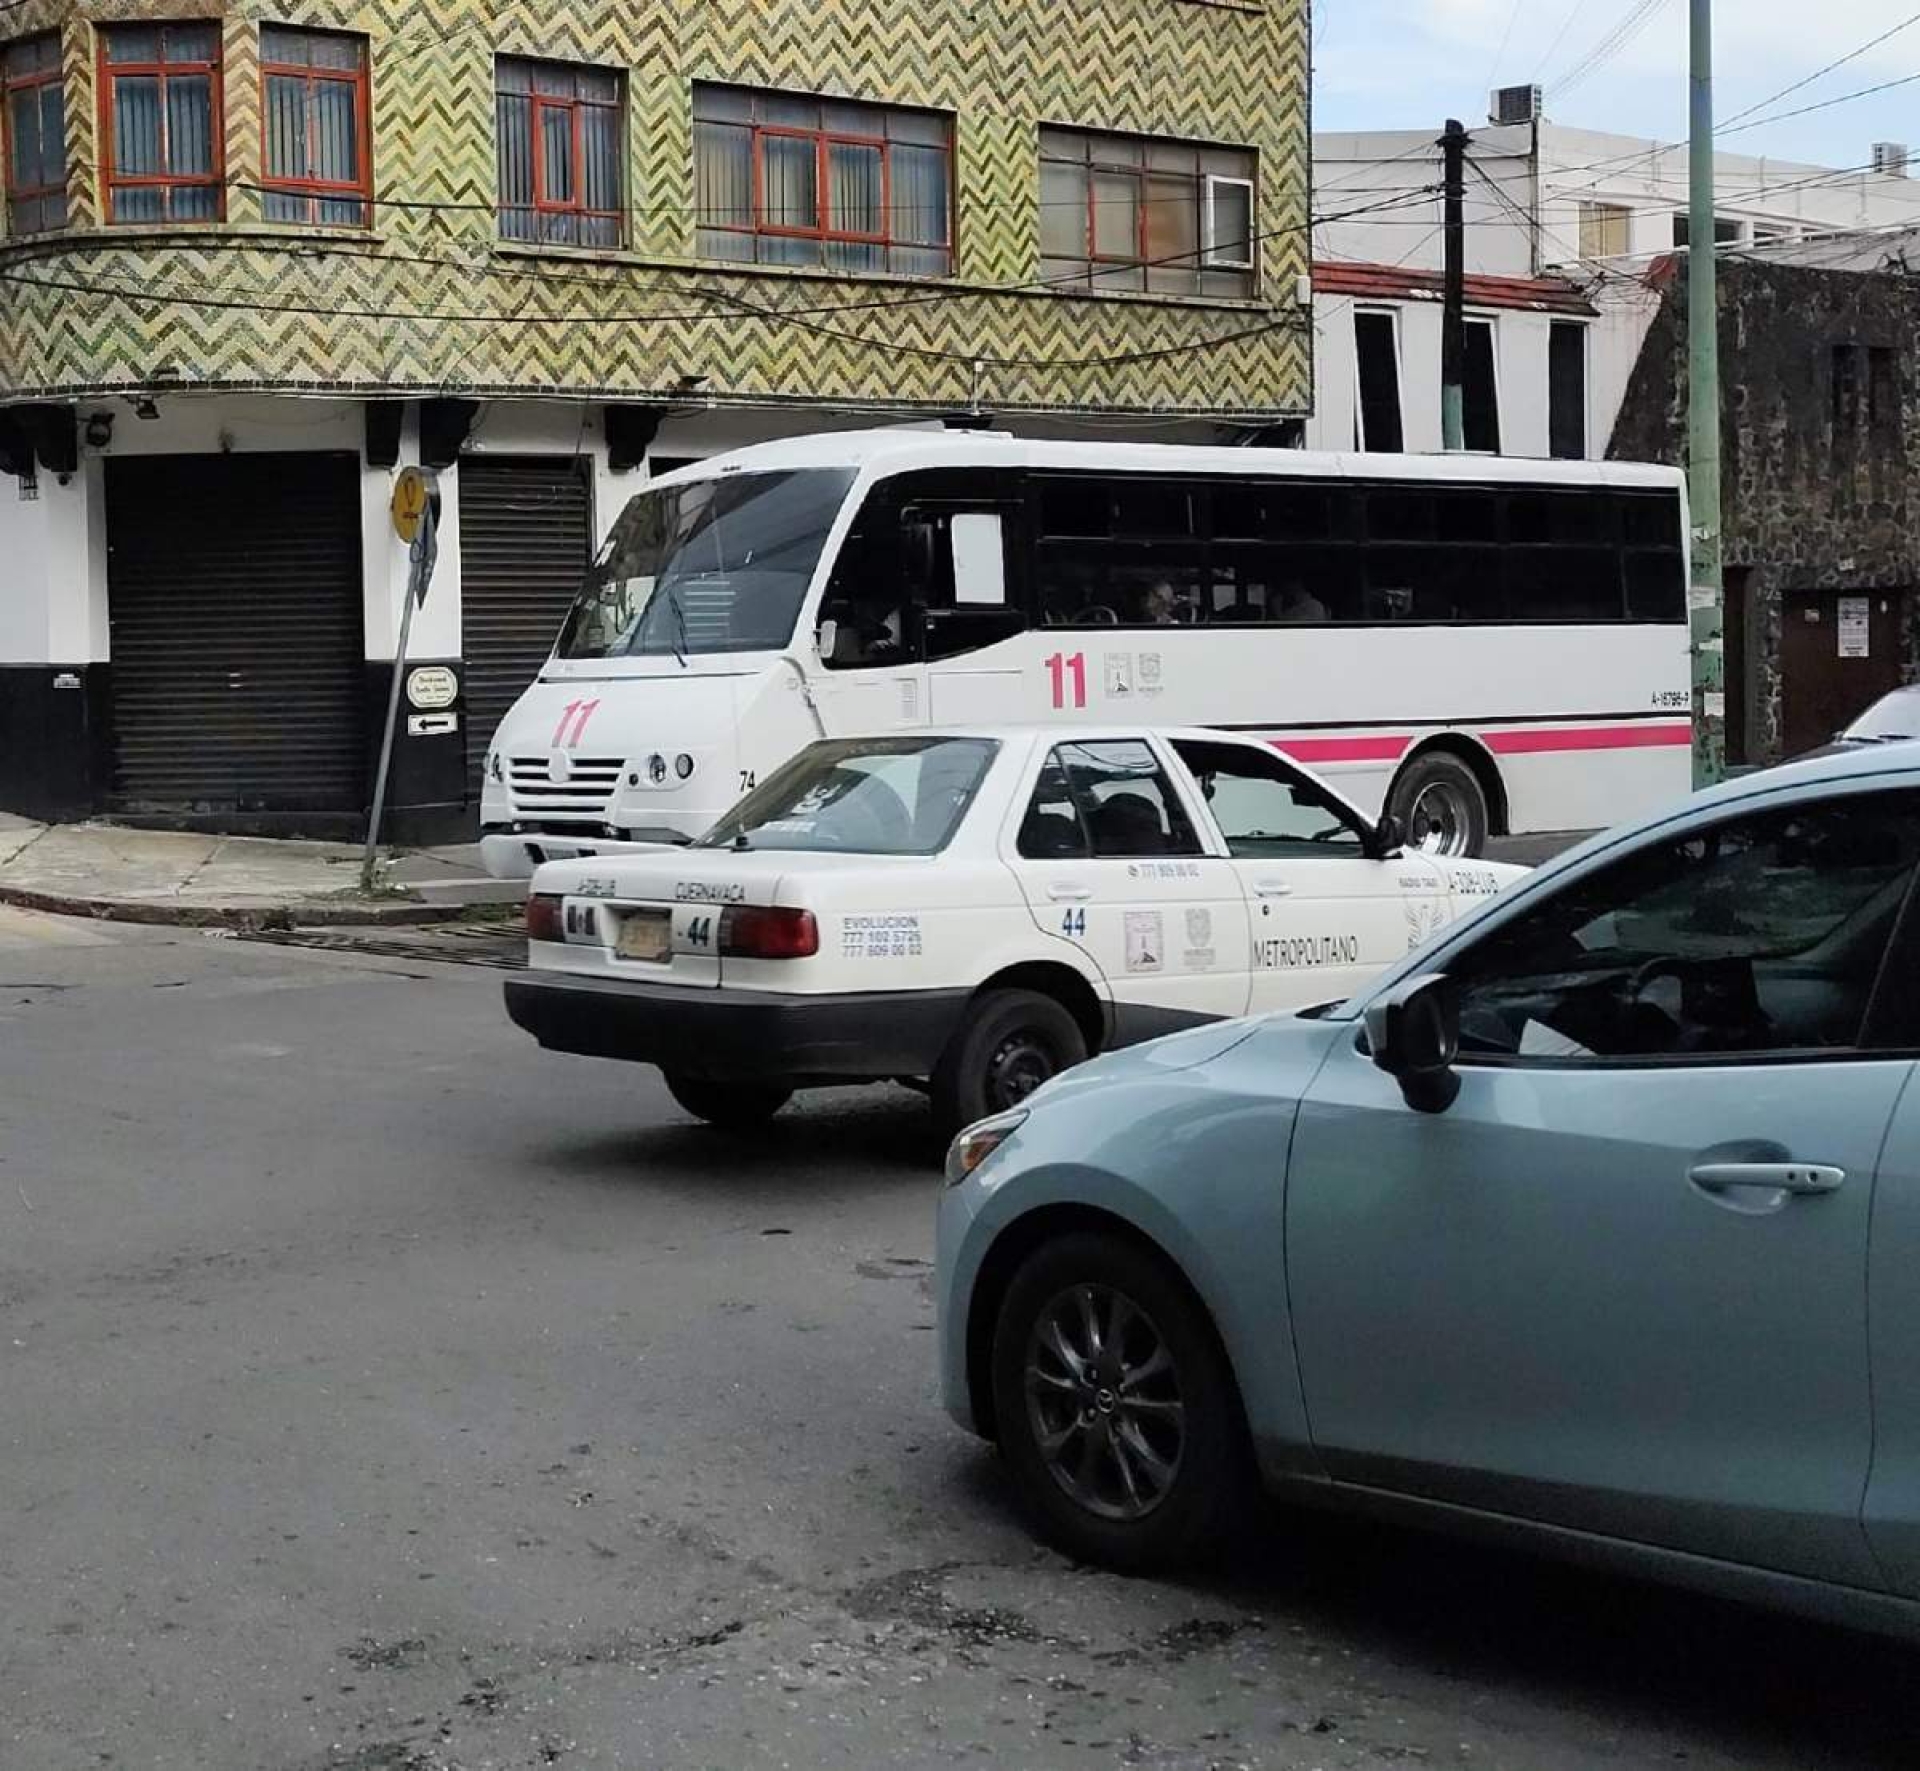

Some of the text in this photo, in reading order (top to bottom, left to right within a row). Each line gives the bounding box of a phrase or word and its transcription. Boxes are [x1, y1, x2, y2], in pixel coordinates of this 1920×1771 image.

[1044, 652, 1086, 709] 11
[551, 699, 600, 748] 11
[675, 882, 745, 902] CUERNAVACA
[844, 916, 919, 930] EVOLUCION
[1062, 907, 1086, 937] 44
[843, 931, 864, 944] 777
[843, 944, 864, 957] 777
[1253, 935, 1358, 968] METROPOLITANO
